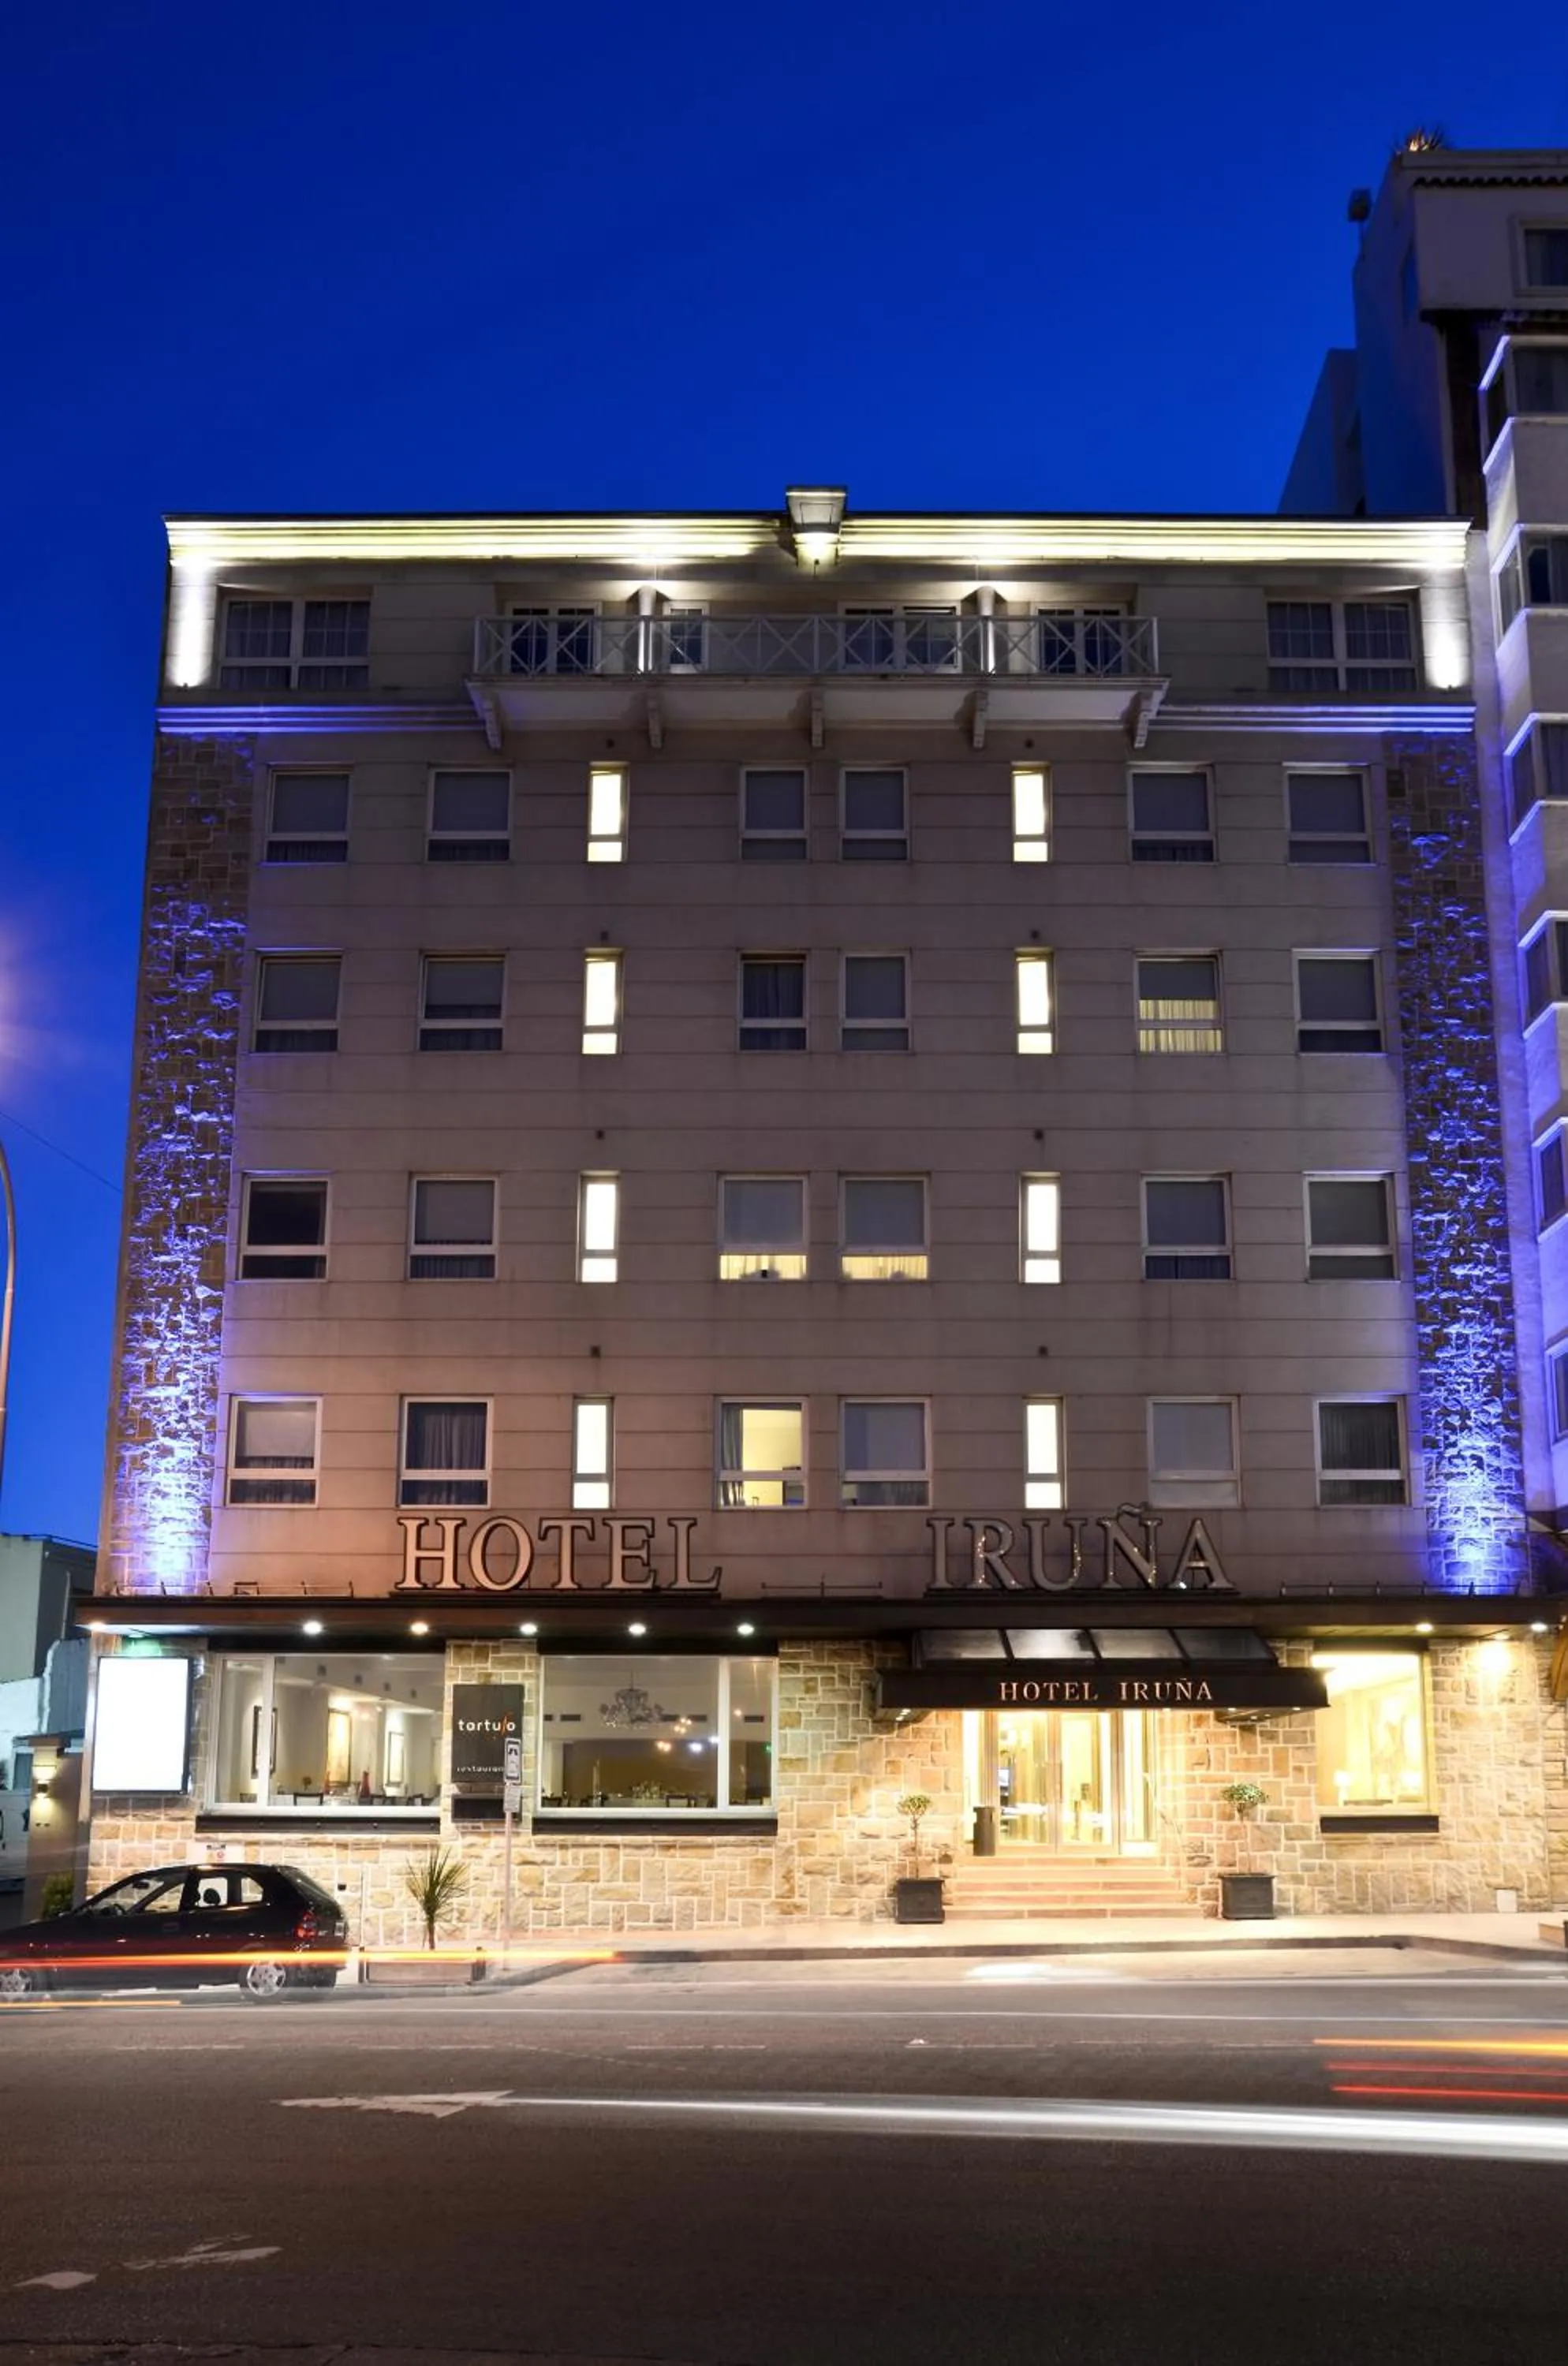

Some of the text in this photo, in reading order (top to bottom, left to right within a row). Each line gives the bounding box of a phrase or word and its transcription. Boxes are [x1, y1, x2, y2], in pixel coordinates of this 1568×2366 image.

[396, 1502, 1235, 1591] HOTEL IRUÑA
[1000, 1677, 1213, 1701] HOTEL IRUÑA
